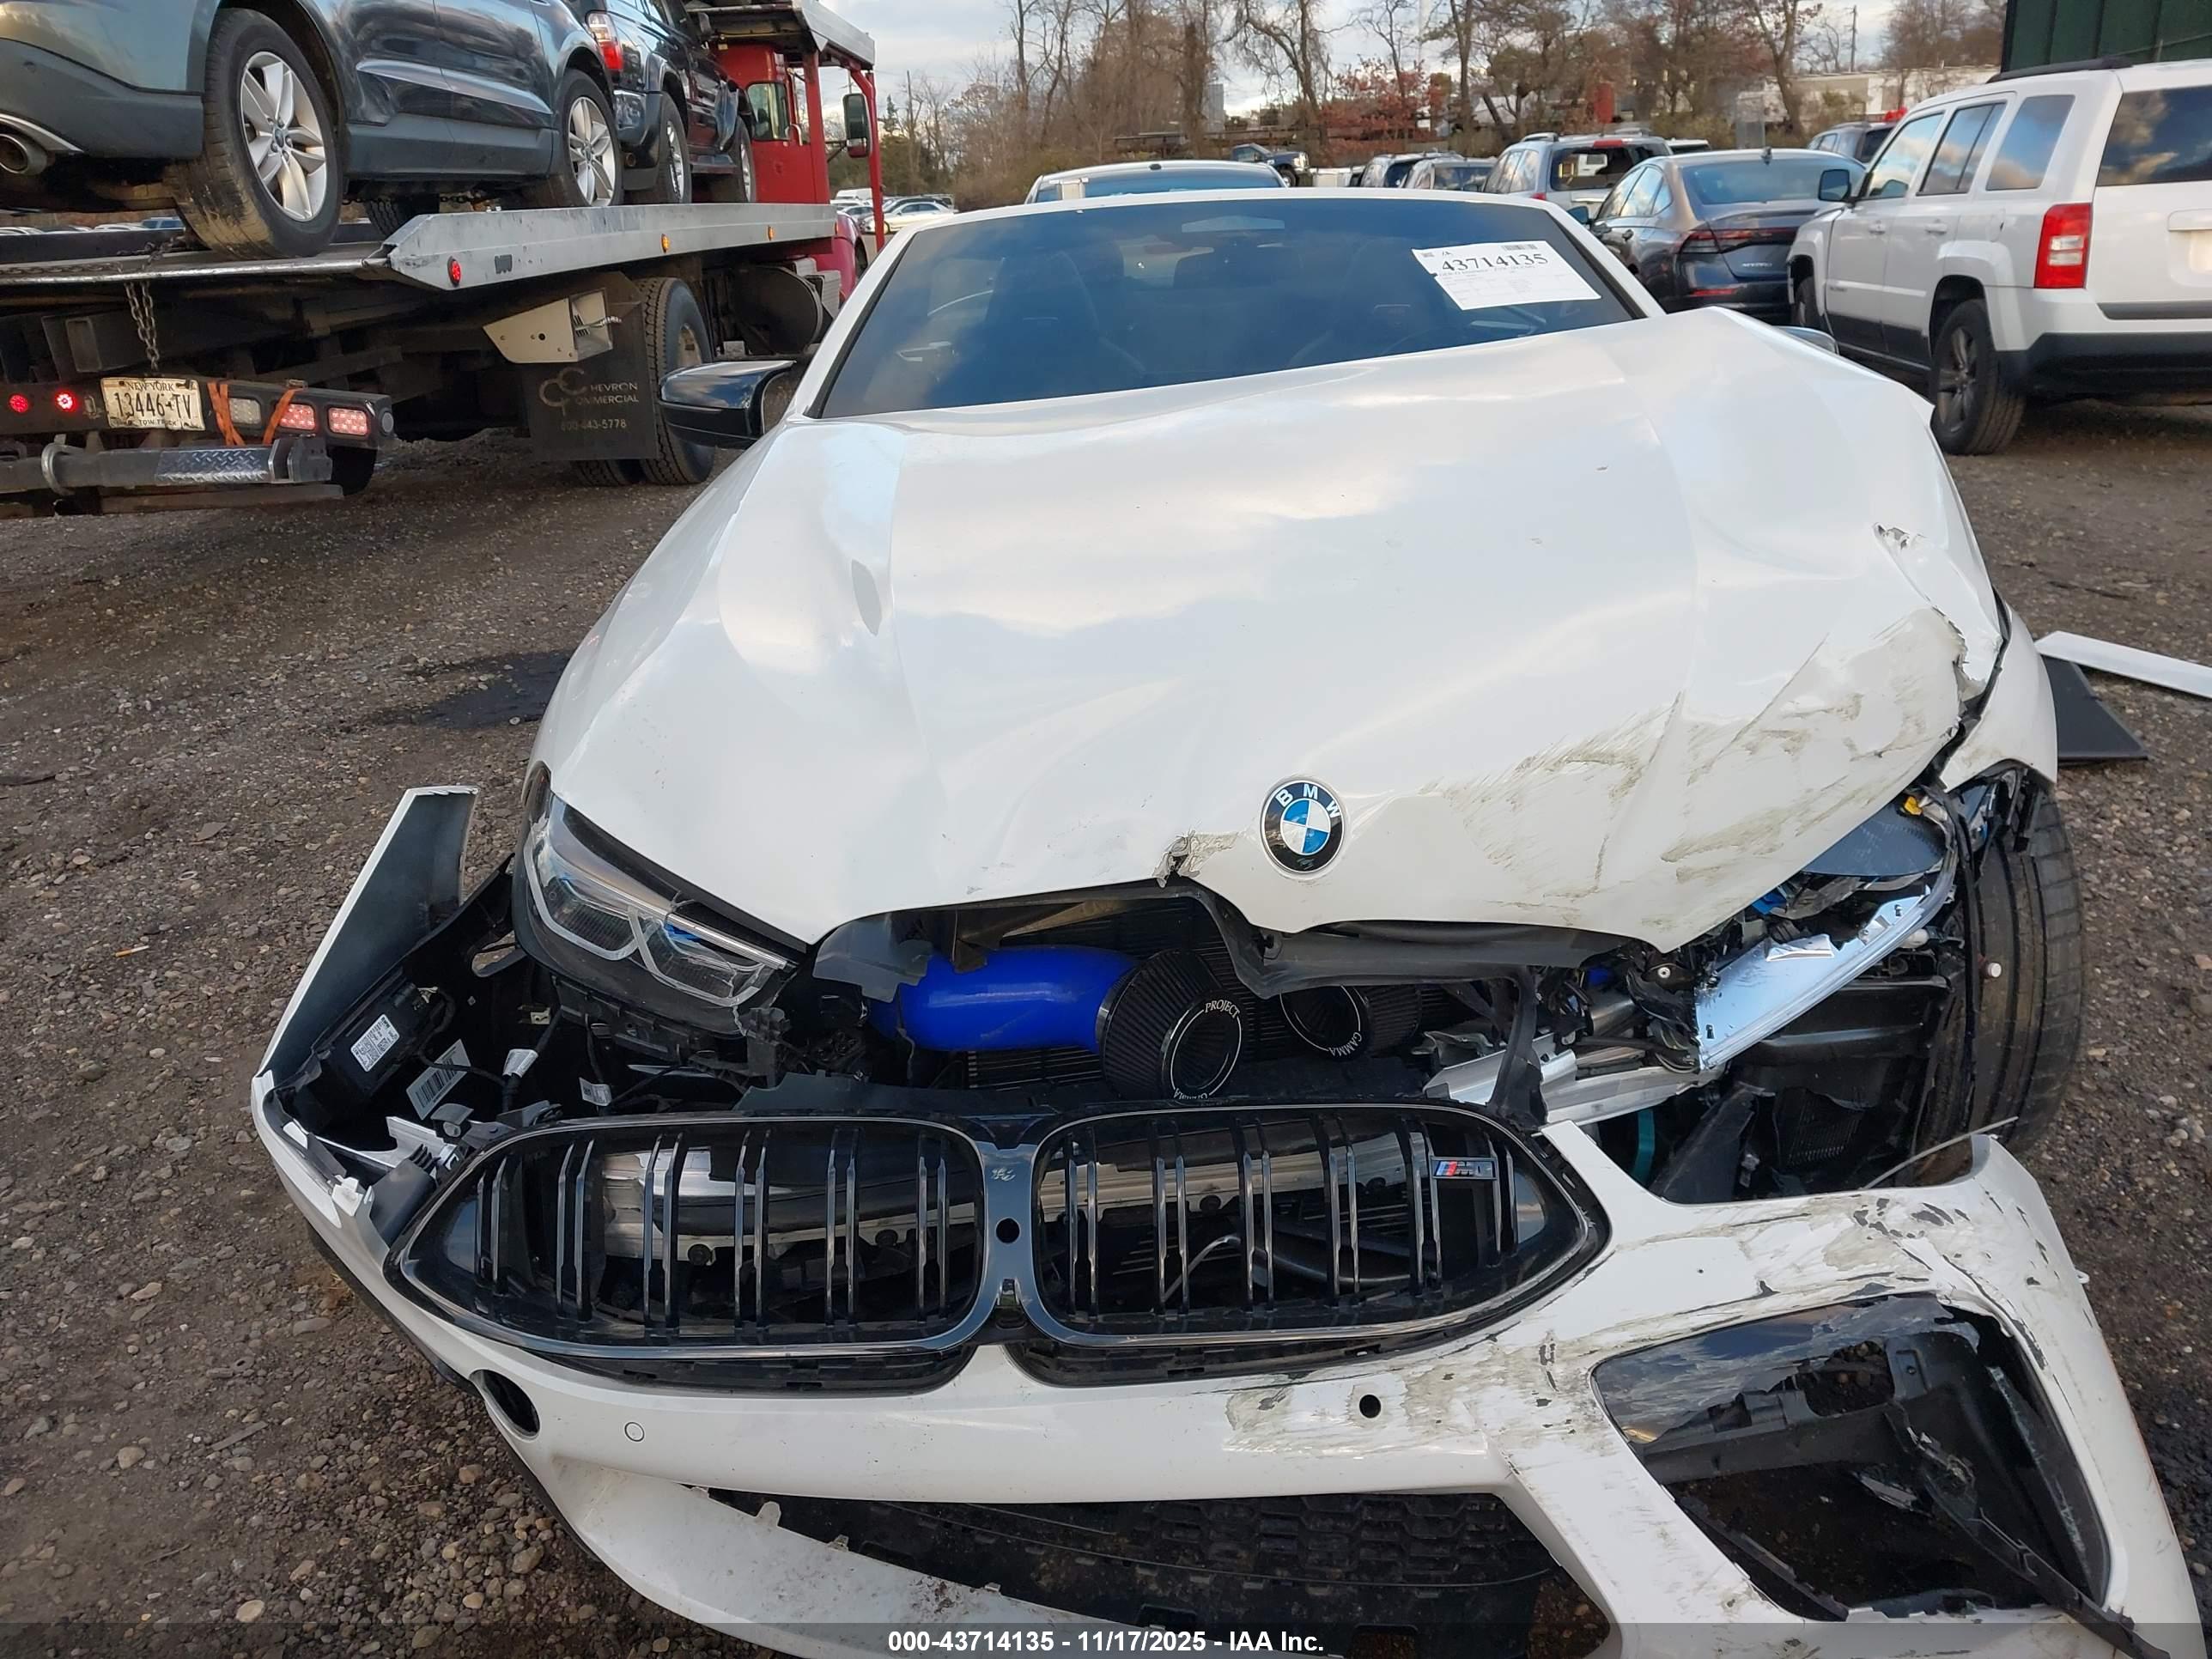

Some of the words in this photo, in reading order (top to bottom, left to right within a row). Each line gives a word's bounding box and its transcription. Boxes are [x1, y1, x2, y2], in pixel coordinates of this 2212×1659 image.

[1442, 253, 1549, 271] 43714135
[126, 382, 147, 392] NEW
[149, 381, 175, 392] YORK
[1275, 783, 1341, 818] BMW
[1204, 999, 1241, 1018] PROJECT
[1328, 1031, 1363, 1057] GAMMA
